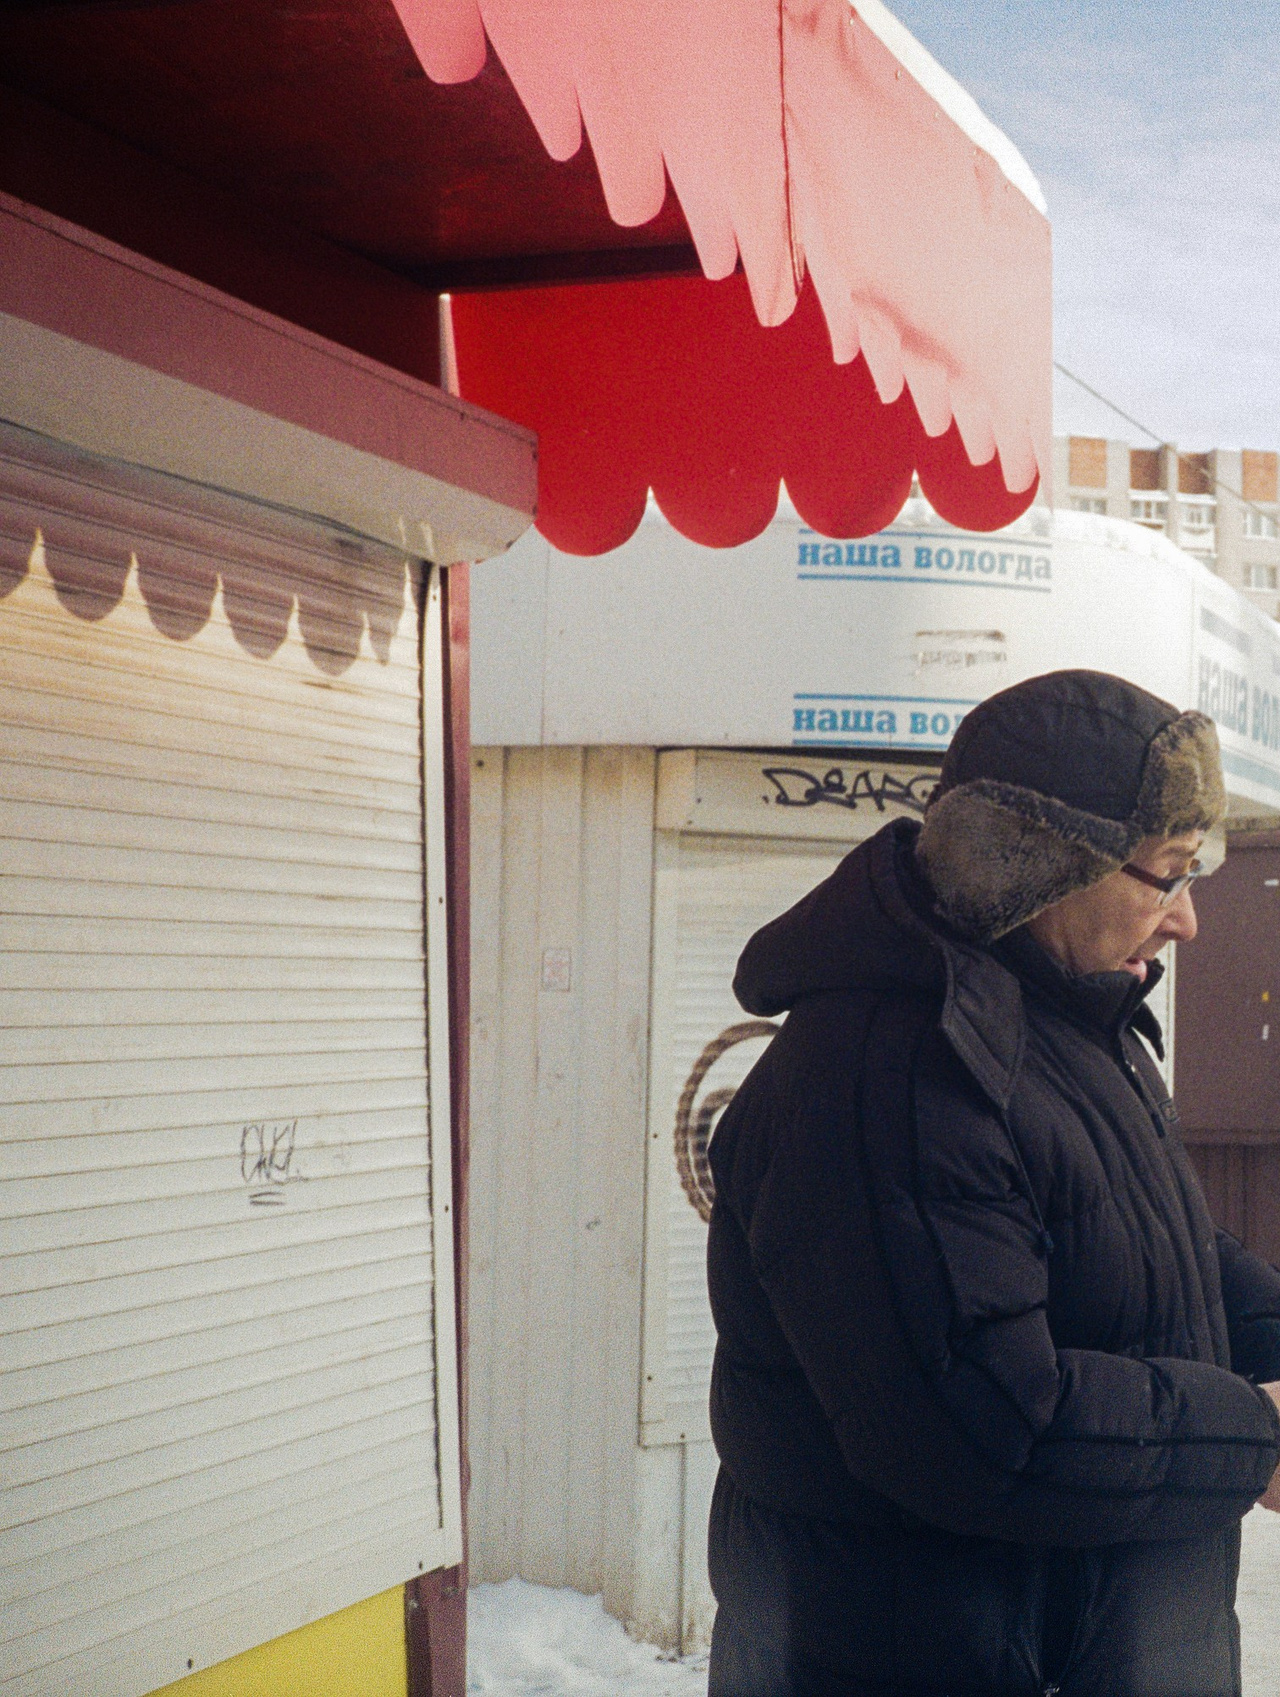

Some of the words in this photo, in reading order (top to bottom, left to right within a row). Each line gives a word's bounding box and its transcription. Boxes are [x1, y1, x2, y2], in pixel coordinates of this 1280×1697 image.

[798, 541, 900, 568] наша
[914, 547, 1051, 579] вологда
[793, 709, 896, 733] наша
